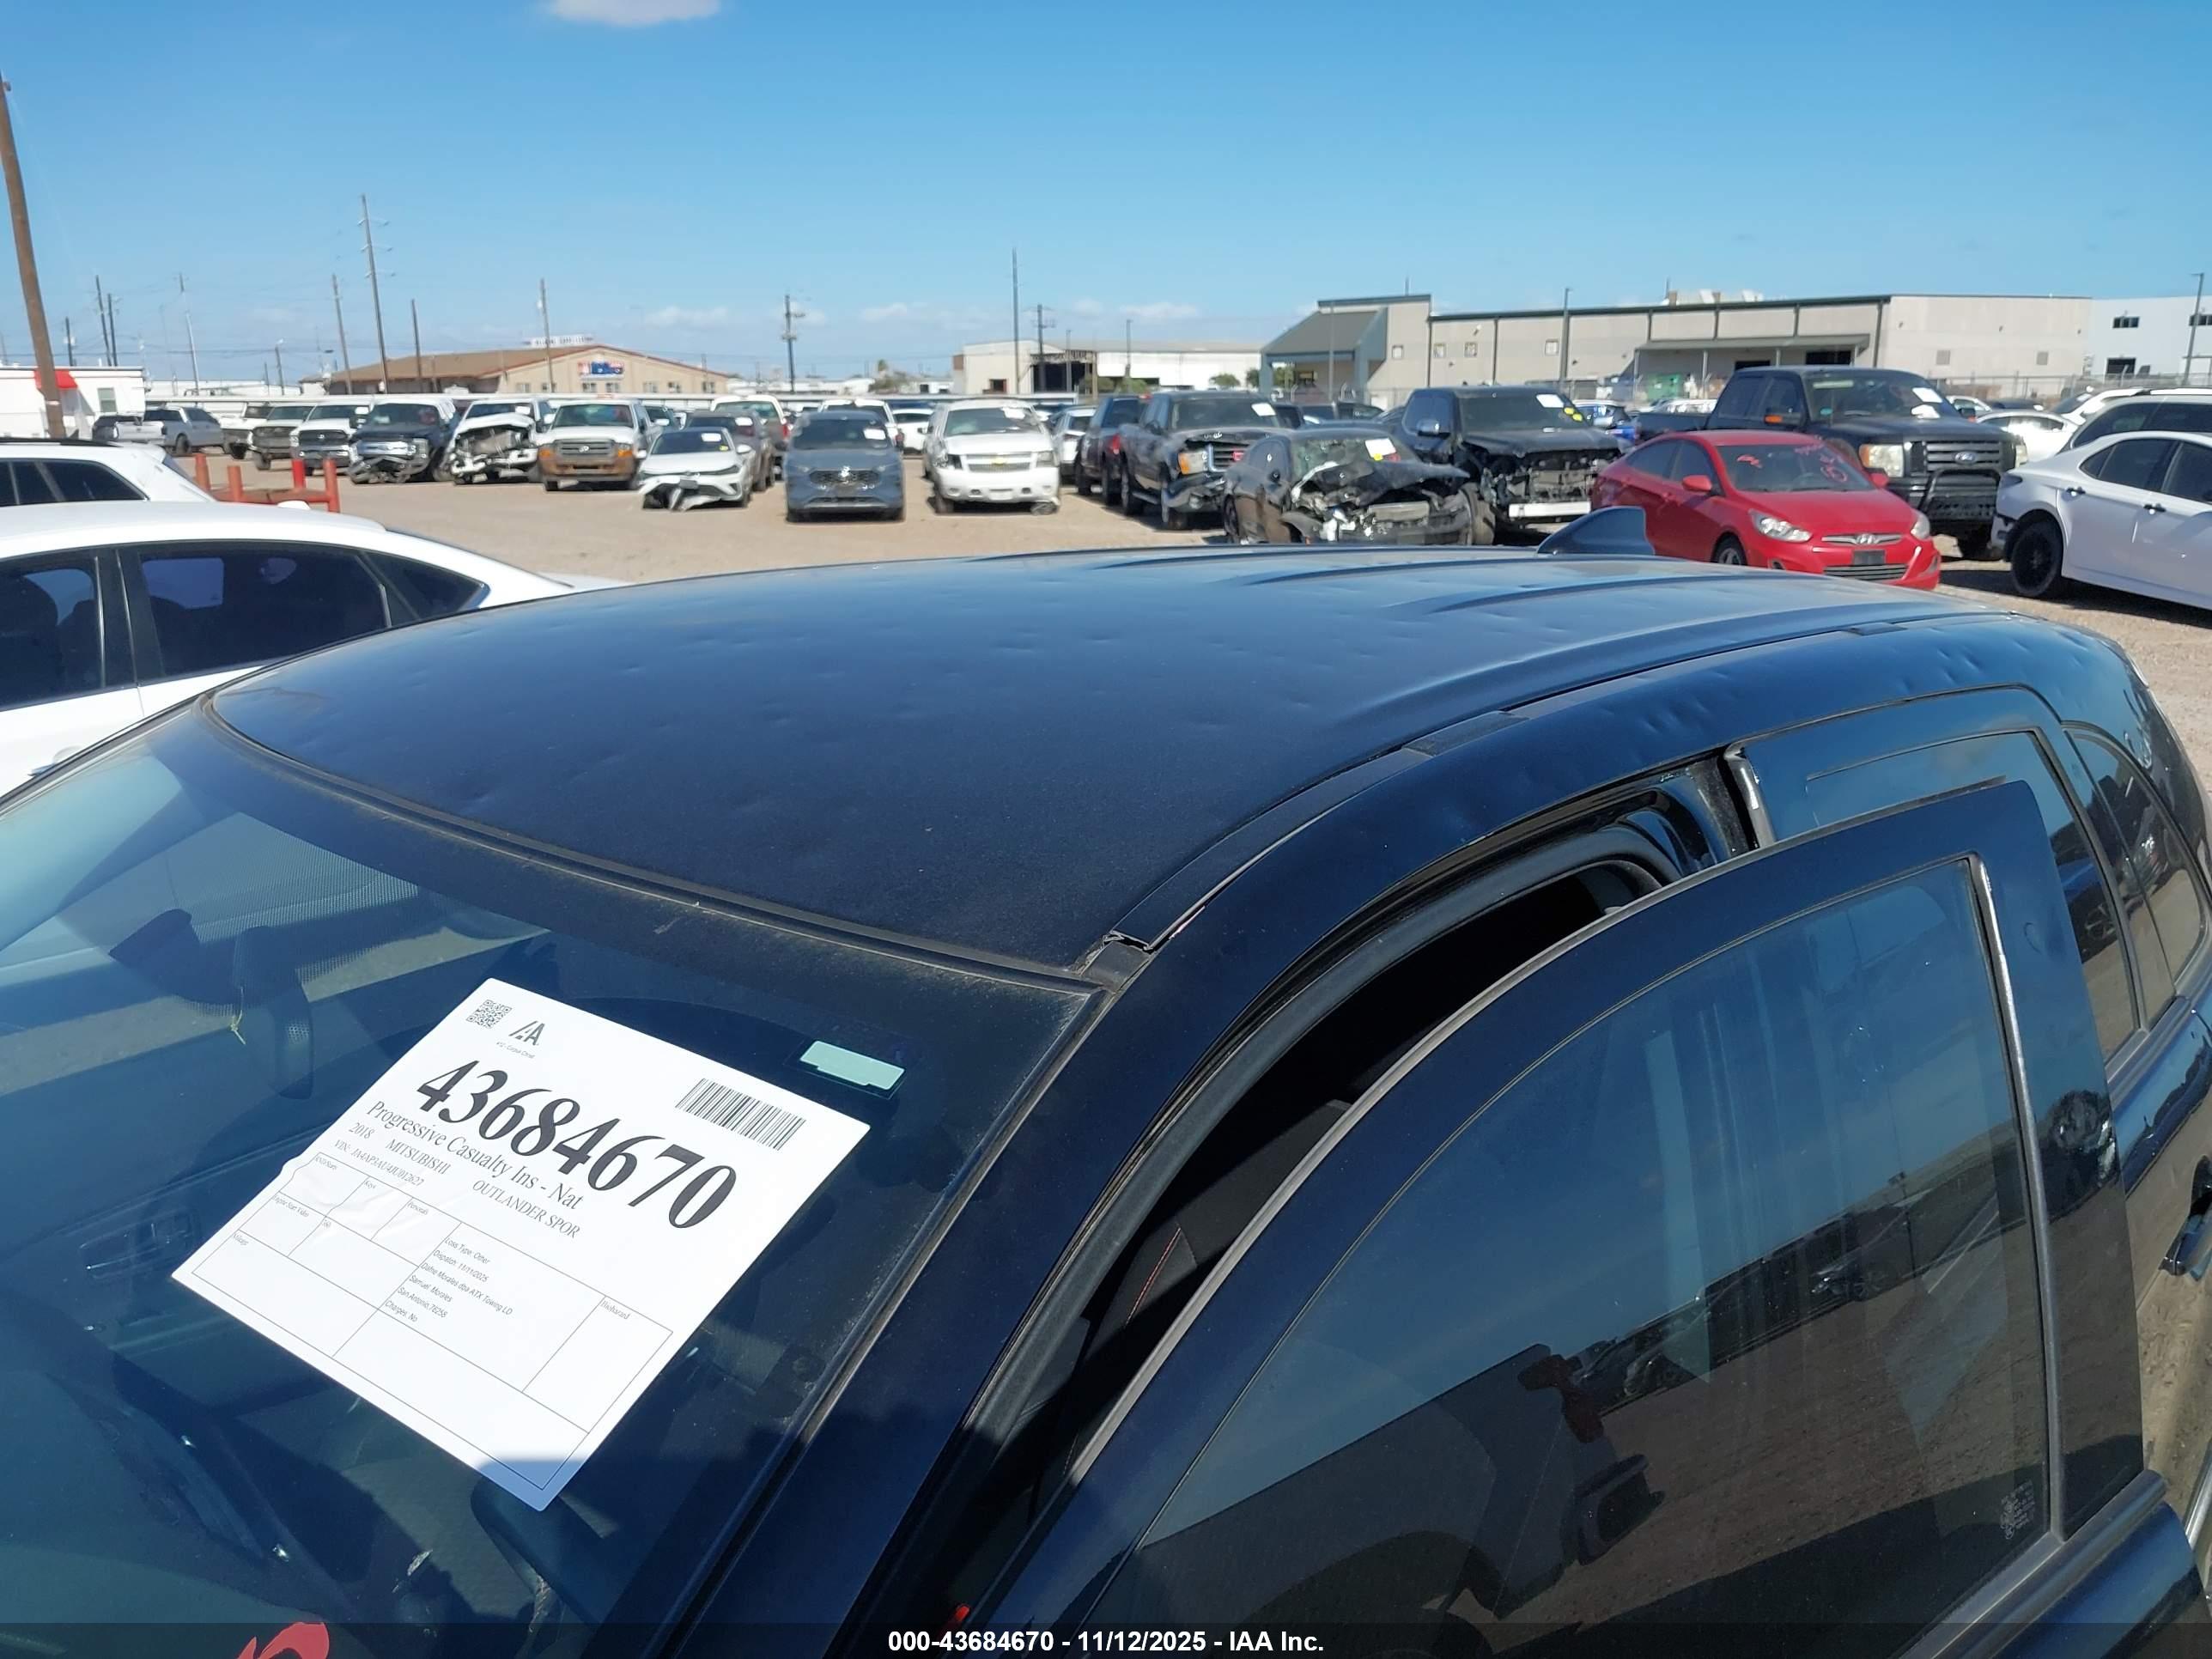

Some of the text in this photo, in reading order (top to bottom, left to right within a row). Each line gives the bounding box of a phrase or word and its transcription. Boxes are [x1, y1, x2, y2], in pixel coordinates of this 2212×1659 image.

[348, 1122, 582, 1239] 2018 MITSUBISHI OUTLANDER SPOR
[366, 1101, 447, 1146] Progressive
[447, 1136, 513, 1178] Casualty
[512, 1165, 538, 1190] Ins
[547, 1183, 585, 1210] Nat
[416, 1060, 737, 1229] 43684670
[469, 1289, 483, 1299] ATX
[482, 1295, 503, 1312] Towing
